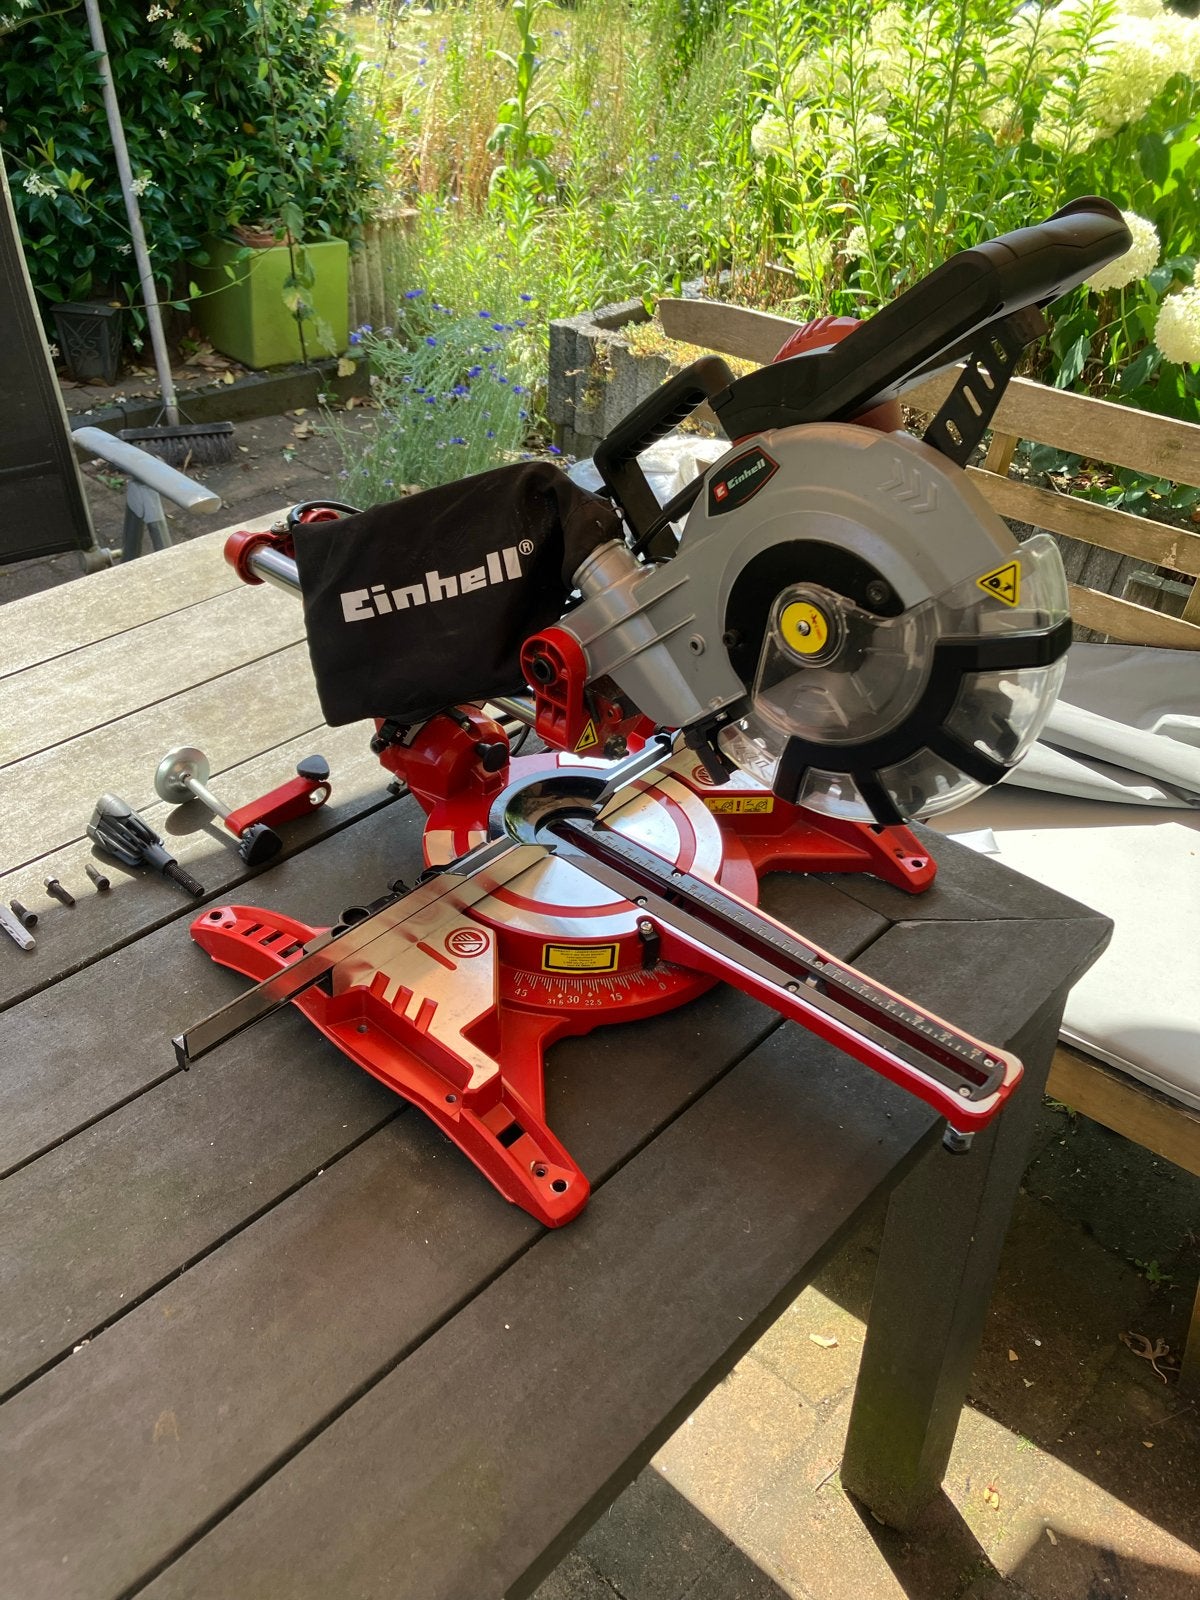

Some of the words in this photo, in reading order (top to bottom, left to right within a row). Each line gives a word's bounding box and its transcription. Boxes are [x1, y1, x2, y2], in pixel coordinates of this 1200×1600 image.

[727, 458, 766, 490] Einhell
[514, 988, 528, 997] 45
[567, 995, 580, 1004] 30
[610, 992, 623, 1001] 15
